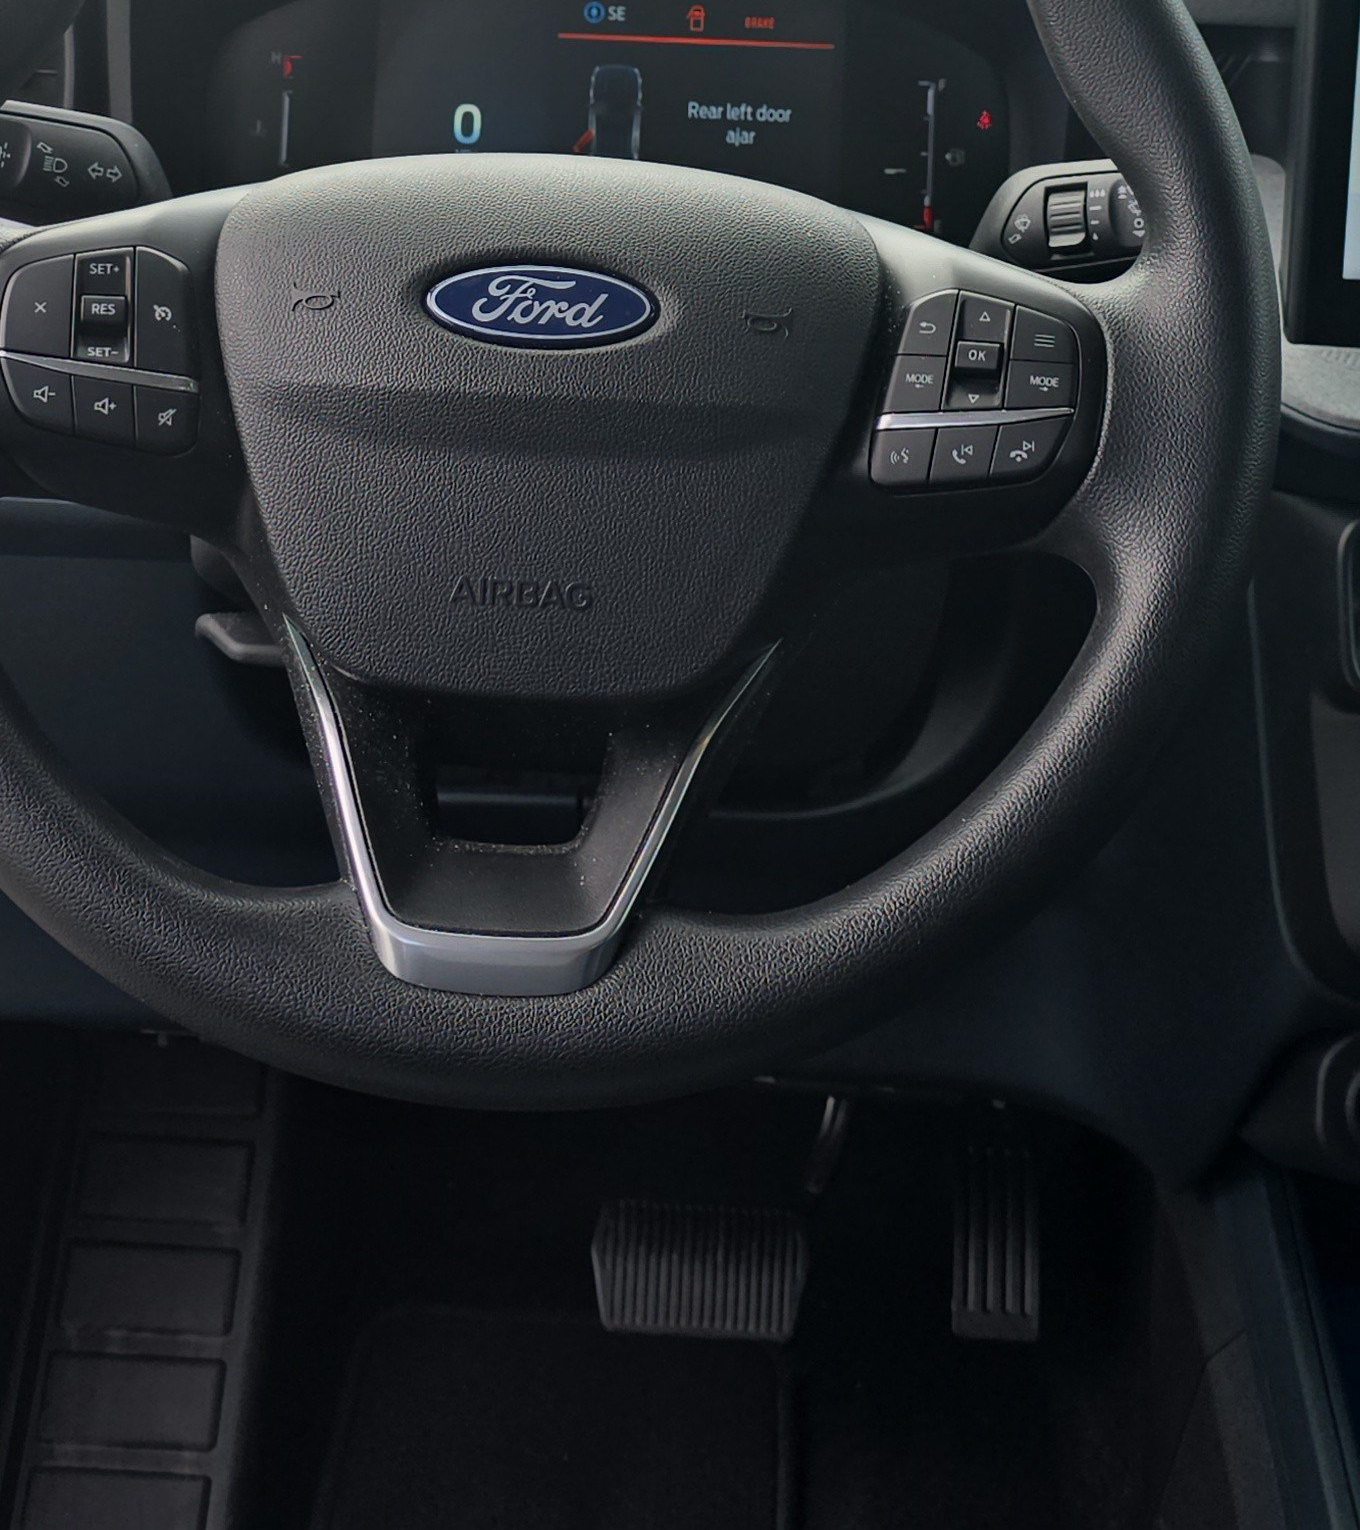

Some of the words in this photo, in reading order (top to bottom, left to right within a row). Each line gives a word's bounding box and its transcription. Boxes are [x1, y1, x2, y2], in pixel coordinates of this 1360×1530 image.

[608, 6, 626, 21] SE
[688, 102, 724, 120] Rear
[726, 103, 753, 121] left
[756, 104, 792, 122] door
[453, 103, 482, 144] 0
[726, 128, 756, 146] ajar
[90, 302, 116, 316] RES
[471, 273, 609, 330] Ford
[968, 349, 985, 362] OK
[905, 373, 934, 385] MODE
[1029, 376, 1059, 389] MODE
[449, 574, 593, 611] AIRBAG
